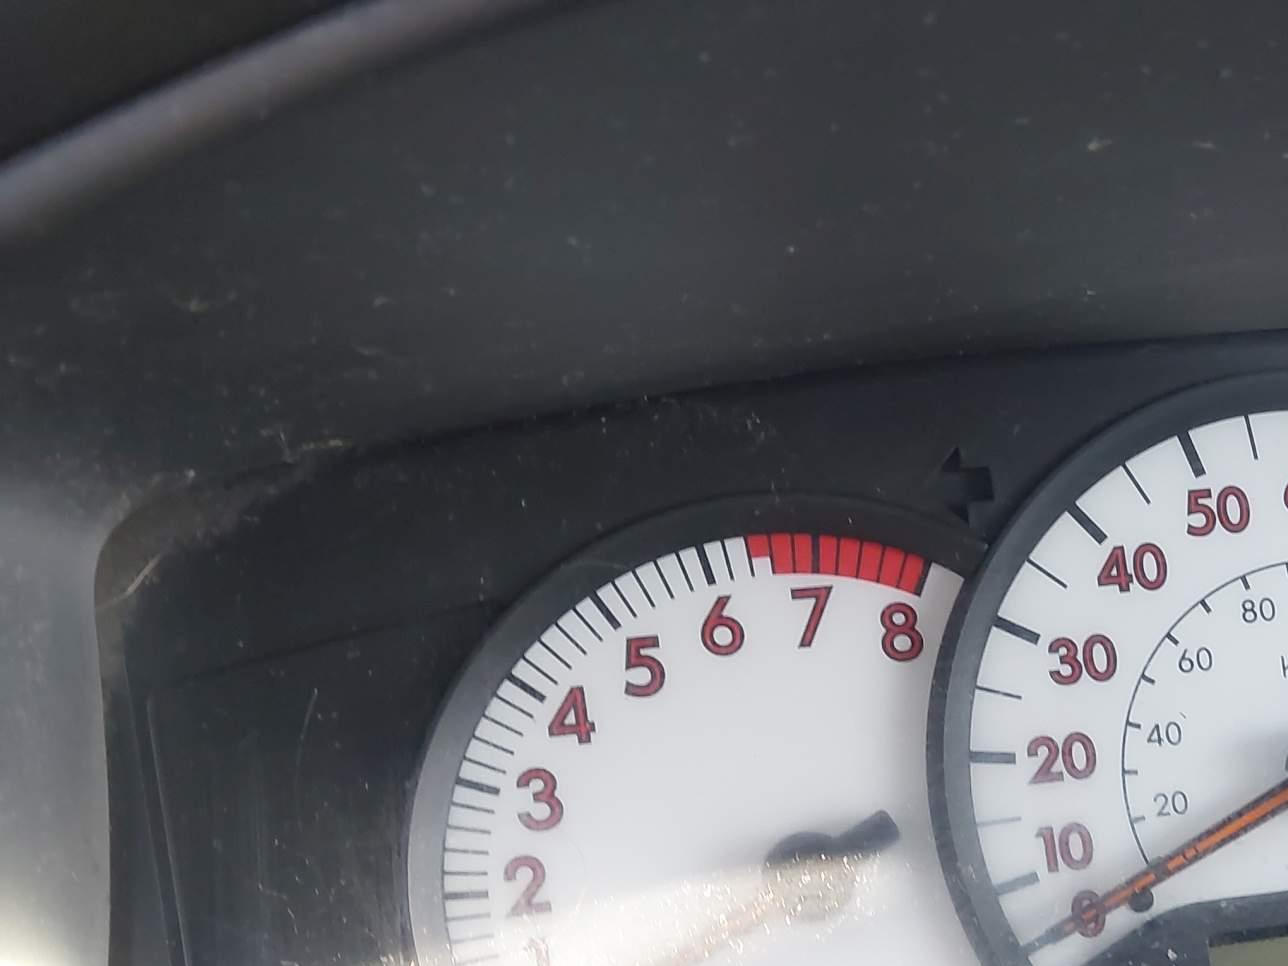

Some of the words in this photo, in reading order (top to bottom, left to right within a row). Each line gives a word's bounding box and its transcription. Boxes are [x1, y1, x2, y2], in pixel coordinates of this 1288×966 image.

[1187, 486, 1250, 536] 50
[1097, 543, 1167, 592] 40
[702, 595, 744, 656] 6
[791, 585, 833, 648] 7
[880, 603, 924, 662] 8
[1241, 598, 1276, 623] 80
[625, 636, 666, 697] 5
[1048, 634, 1117, 685] 30
[1178, 647, 1213, 673] 60
[548, 686, 596, 744] 4
[1146, 721, 1182, 747] 40
[1026, 732, 1097, 785] 20
[516, 768, 563, 831] 3
[1153, 791, 1189, 816] 20
[1035, 822, 1094, 873] 10
[504, 856, 552, 918] 2
[1071, 889, 1106, 938] 0
